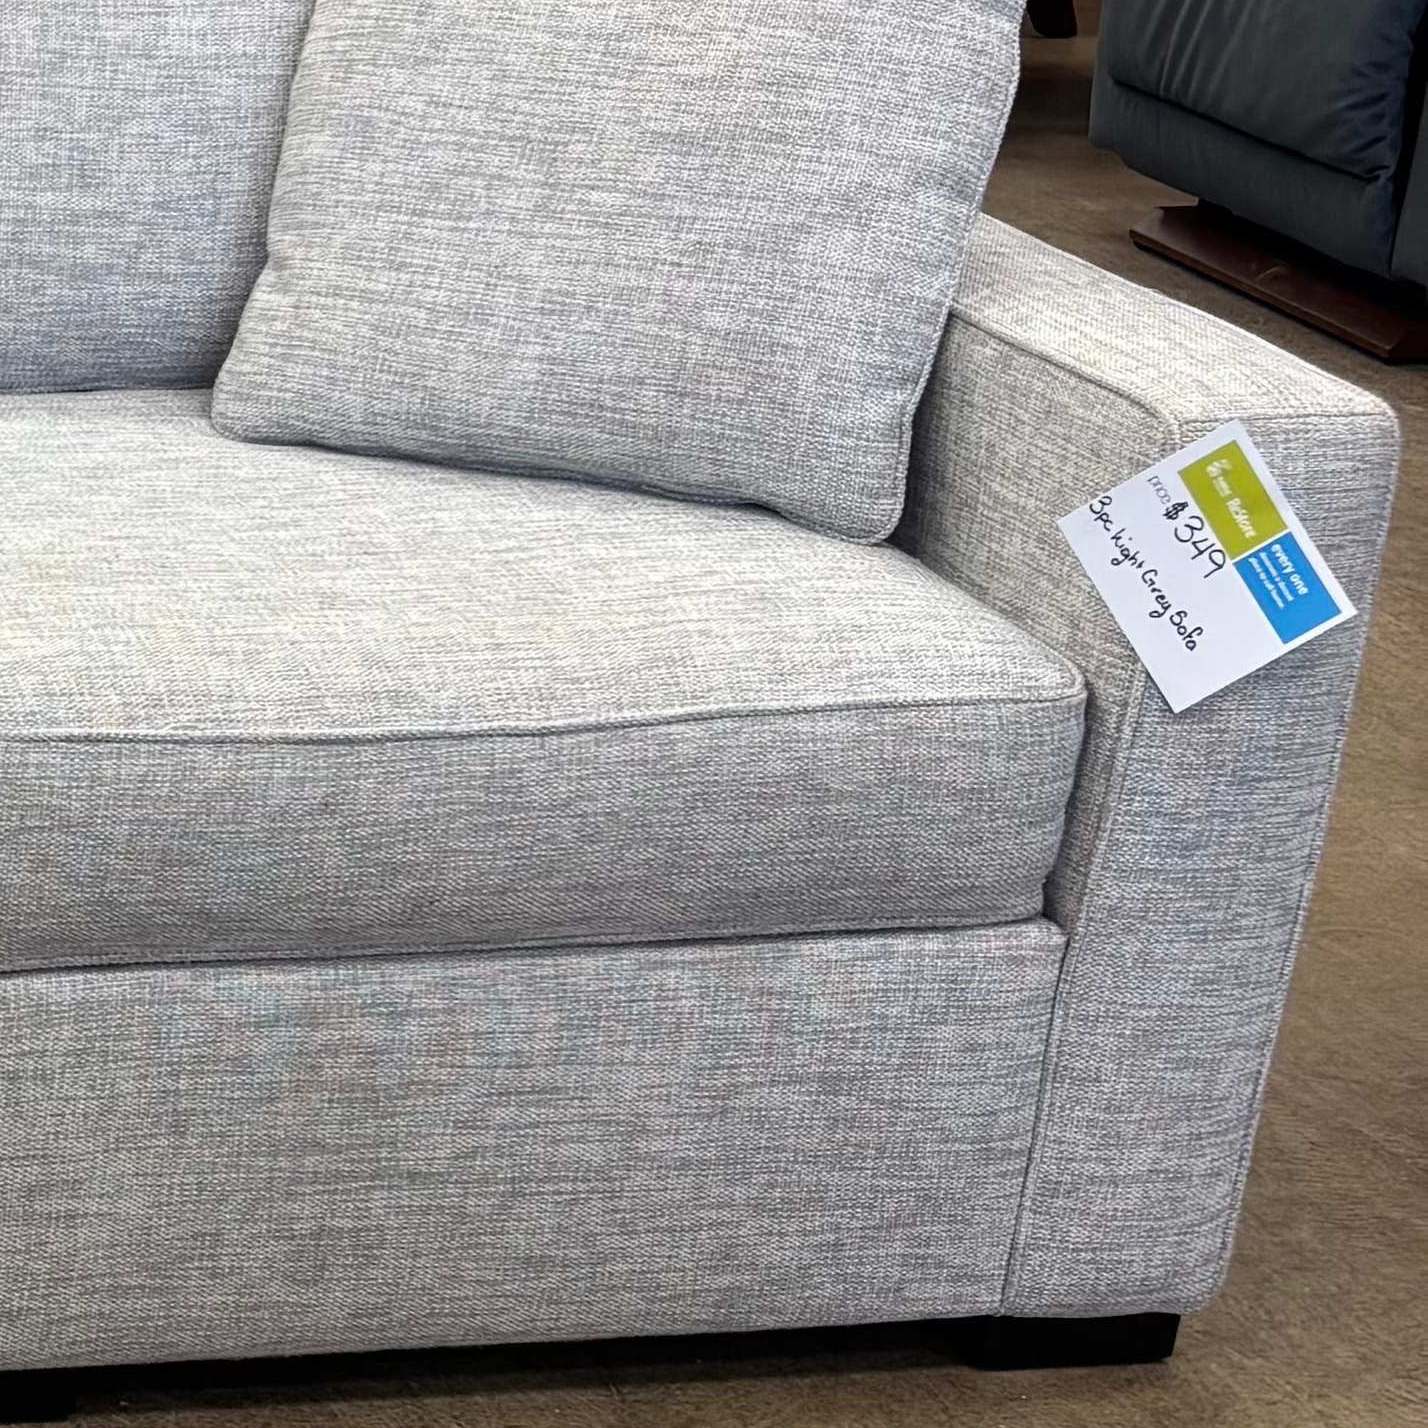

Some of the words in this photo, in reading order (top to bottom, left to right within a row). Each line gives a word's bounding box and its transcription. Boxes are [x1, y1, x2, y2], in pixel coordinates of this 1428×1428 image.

[1271, 543, 1294, 573] every
[1290, 573, 1309, 595] one
[1141, 568, 1172, 618] Grey
[1169, 610, 1204, 651] Sofa
